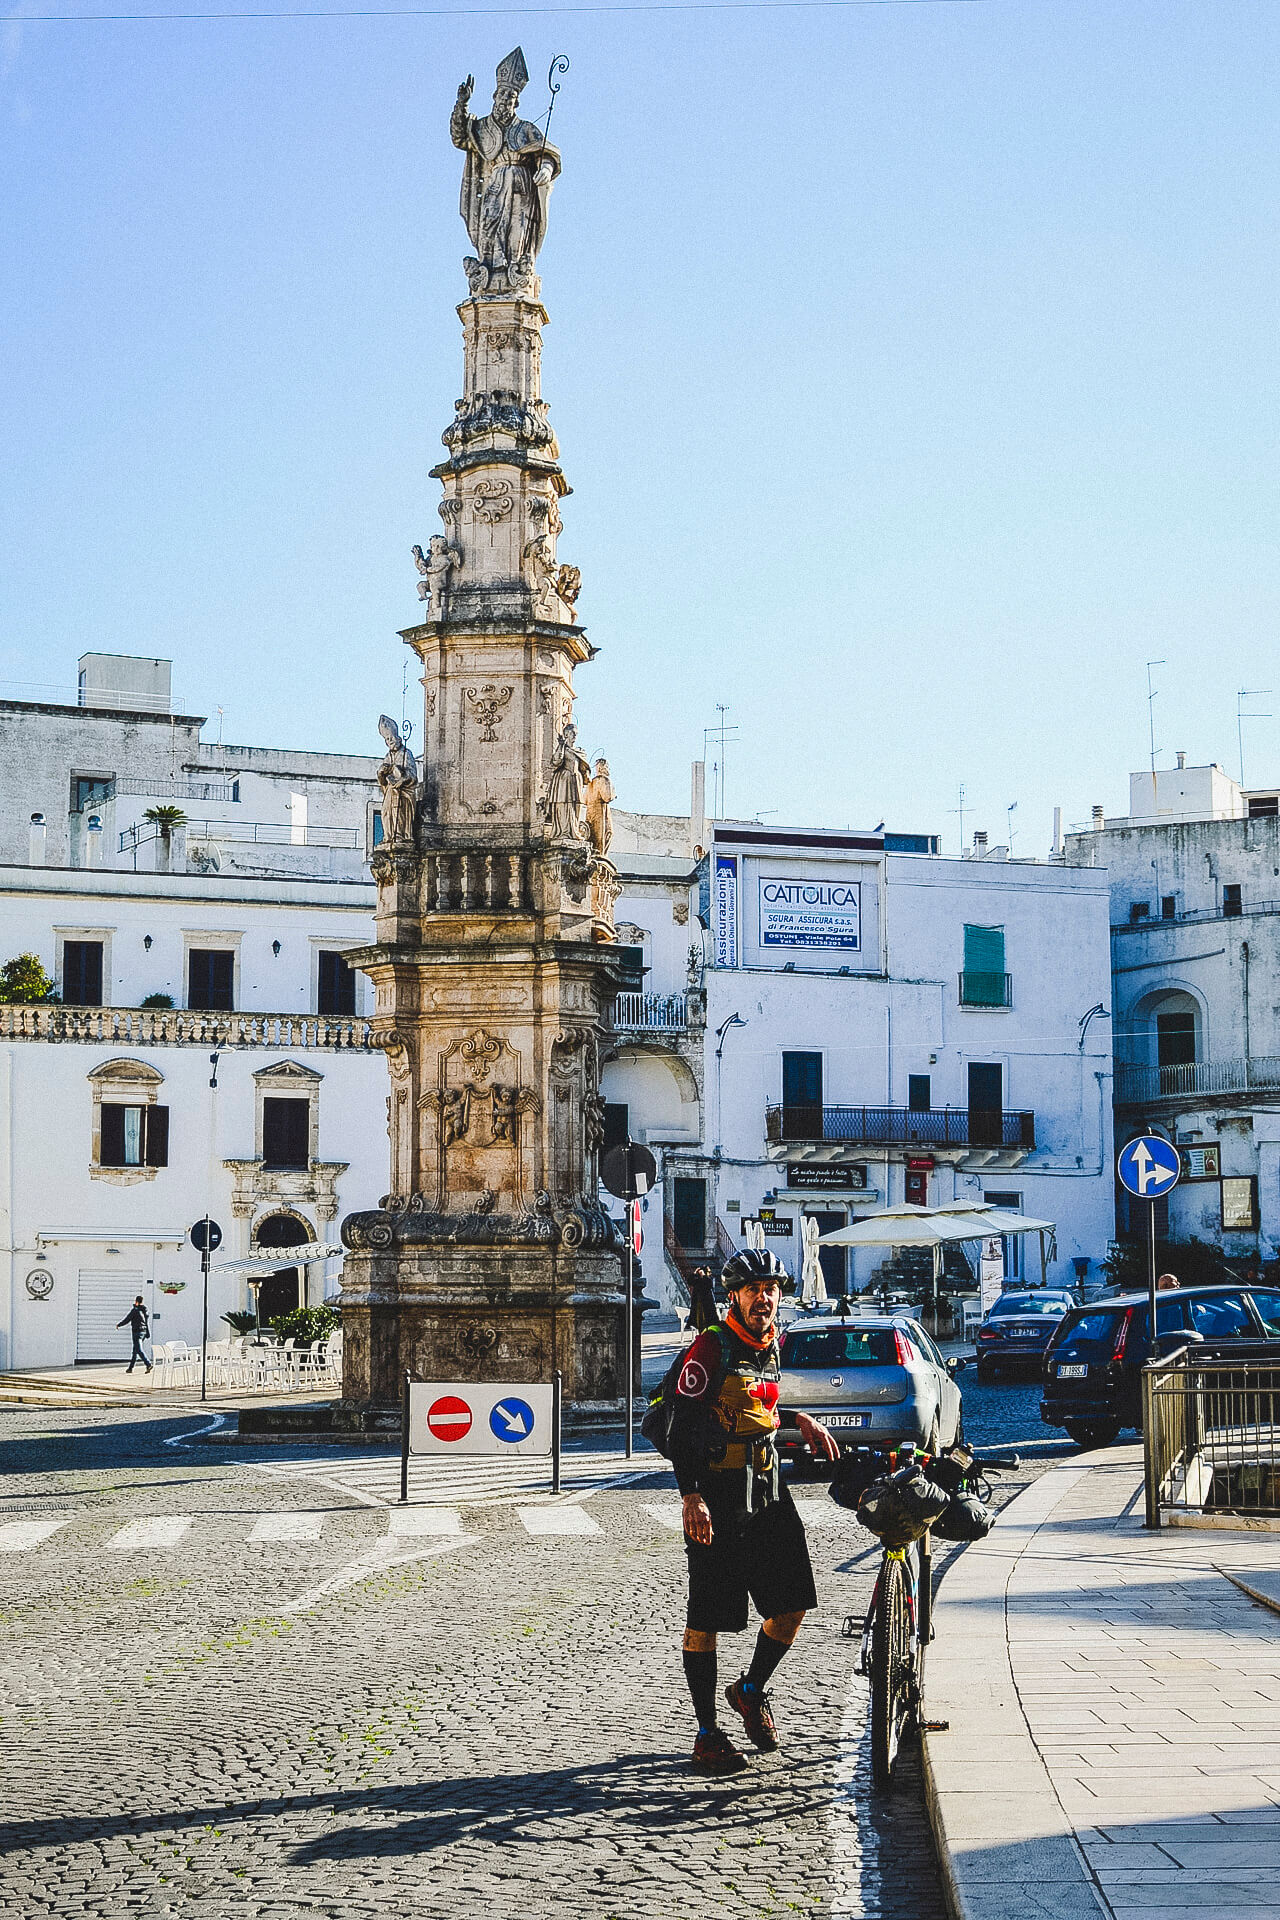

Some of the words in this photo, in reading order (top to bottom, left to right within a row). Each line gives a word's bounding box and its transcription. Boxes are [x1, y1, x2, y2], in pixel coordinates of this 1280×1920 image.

[716, 867, 734, 878] AXA
[763, 884, 858, 907] CATTOLICA
[717, 879, 727, 965] Assicurazioni
[767, 914, 794, 923] SGURA
[798, 915, 834, 925] ASSICURA
[779, 924, 825, 932] Francesco
[827, 926, 854, 934] Sgura
